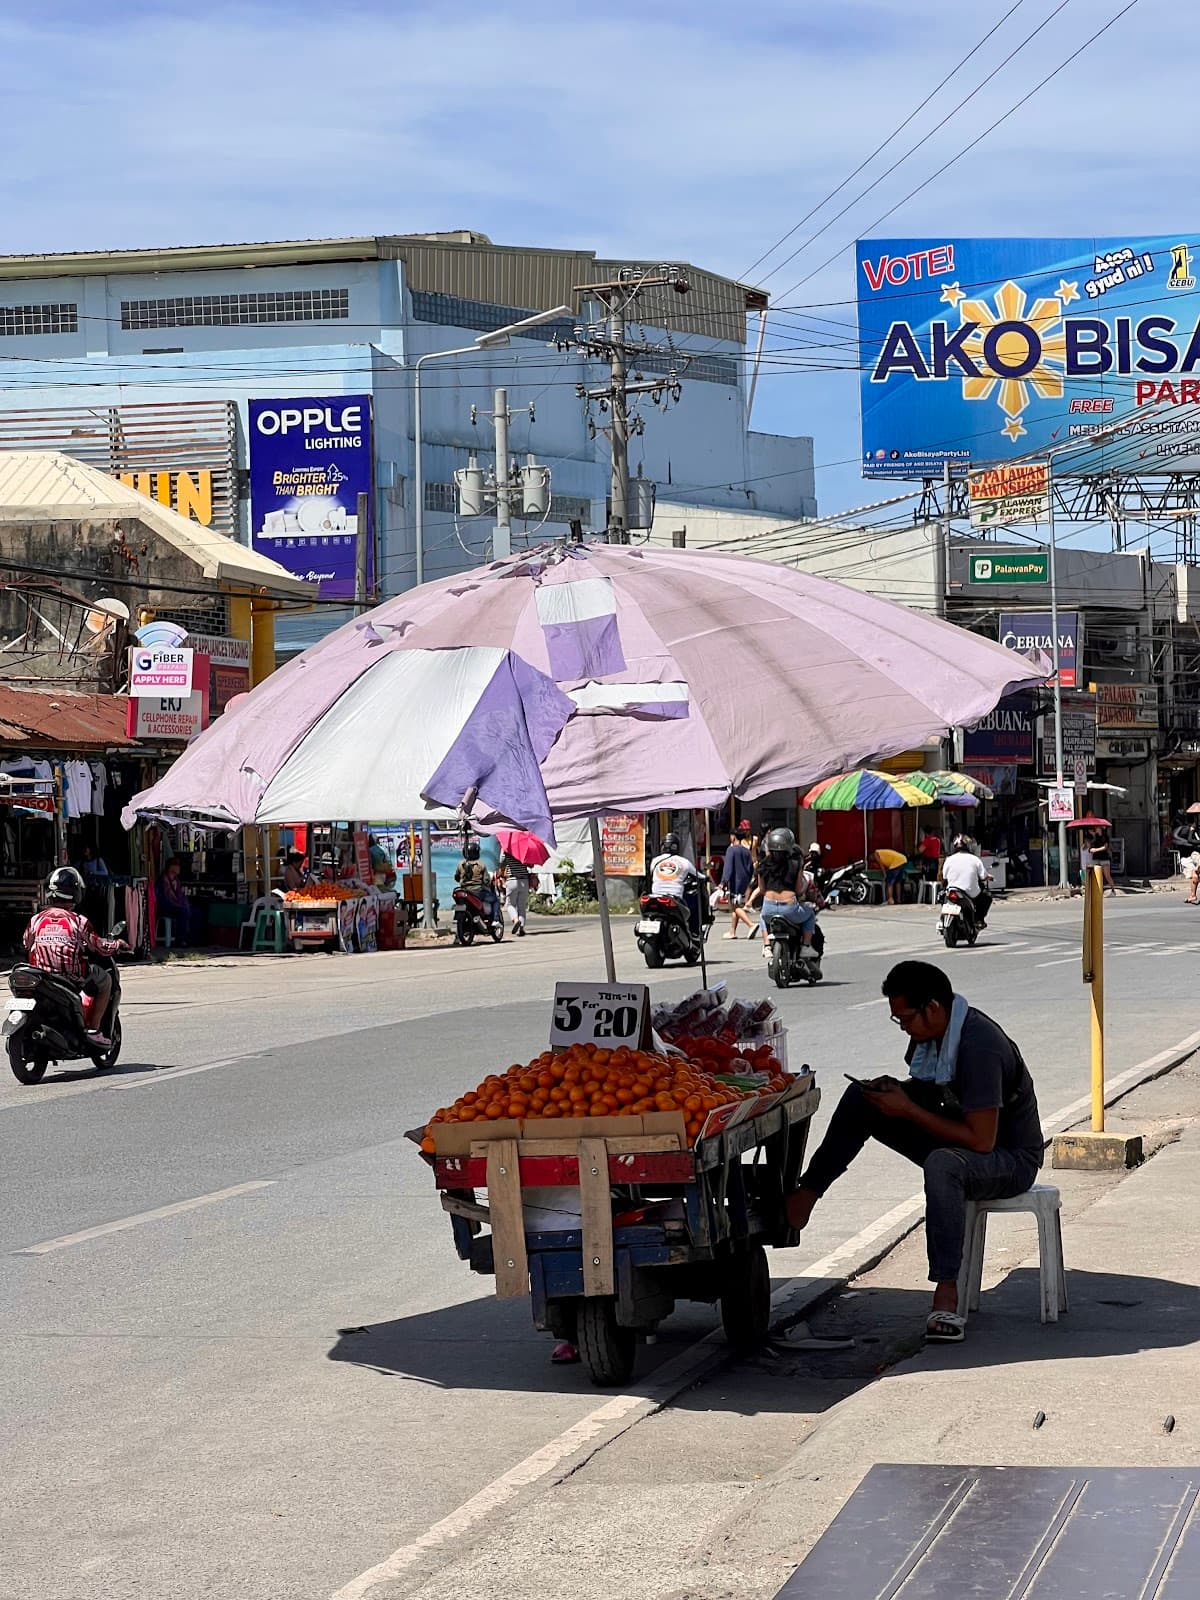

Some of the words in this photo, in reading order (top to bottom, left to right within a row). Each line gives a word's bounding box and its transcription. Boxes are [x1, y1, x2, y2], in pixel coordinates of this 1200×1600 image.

[862, 245, 955, 290] VOTE!
[1085, 268, 1125, 299] gyud
[1126, 259, 1144, 279] ni
[1170, 279, 1194, 287] CEBU
[871, 320, 1042, 381] AKO
[1070, 398, 1114, 413] FREE
[257, 406, 361, 435] OPPLE
[305, 436, 361, 450] LIGHTING
[273, 471, 326, 484] BRIGHTER
[984, 466, 1045, 484] PALAWAN
[275, 487, 296, 496] THAN
[296, 484, 339, 496] BRIGHT
[971, 480, 1045, 497] PAWNSHOP
[1000, 506, 1042, 516] EXPRESS
[995, 564, 1043, 574] PalawanPay
[1002, 631, 1074, 650] CEBUANA
[135, 675, 161, 684] APPLY
[162, 676, 185, 684] HERE
[142, 713, 177, 724] CELLPHONE
[178, 714, 198, 724] REPAIR
[967, 711, 1032, 734] EBUANA
[153, 724, 192, 735] ACCESSORIES
[554, 997, 582, 1031] 3
[583, 1001, 599, 1009] For
[594, 1007, 637, 1037] 20
